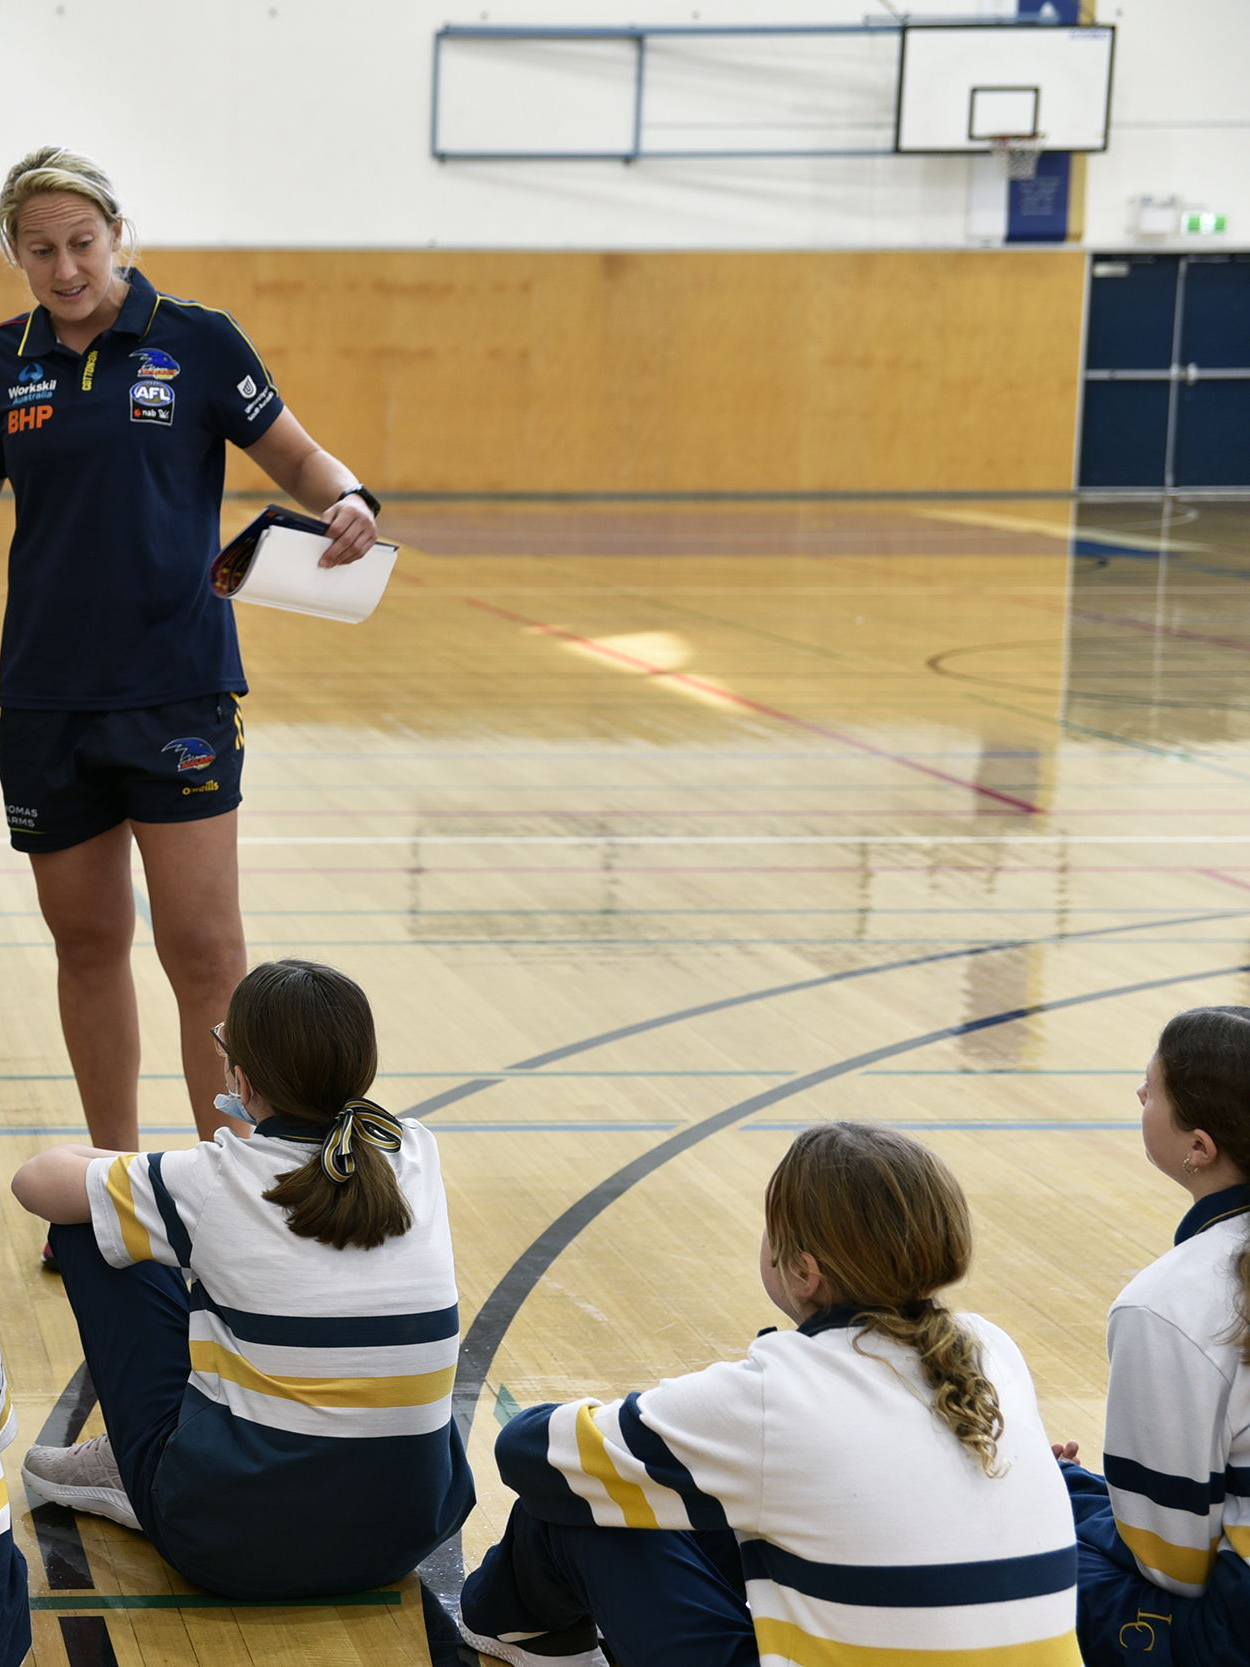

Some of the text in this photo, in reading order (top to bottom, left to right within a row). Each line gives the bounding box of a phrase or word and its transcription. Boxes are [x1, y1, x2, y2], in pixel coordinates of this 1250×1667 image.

[8, 379, 57, 400] Workskil
[134, 386, 171, 401] AFL
[12, 391, 53, 406] Australia
[7, 404, 54, 434] BHP
[142, 408, 157, 418] nab
[5, 804, 39, 818] OMAS
